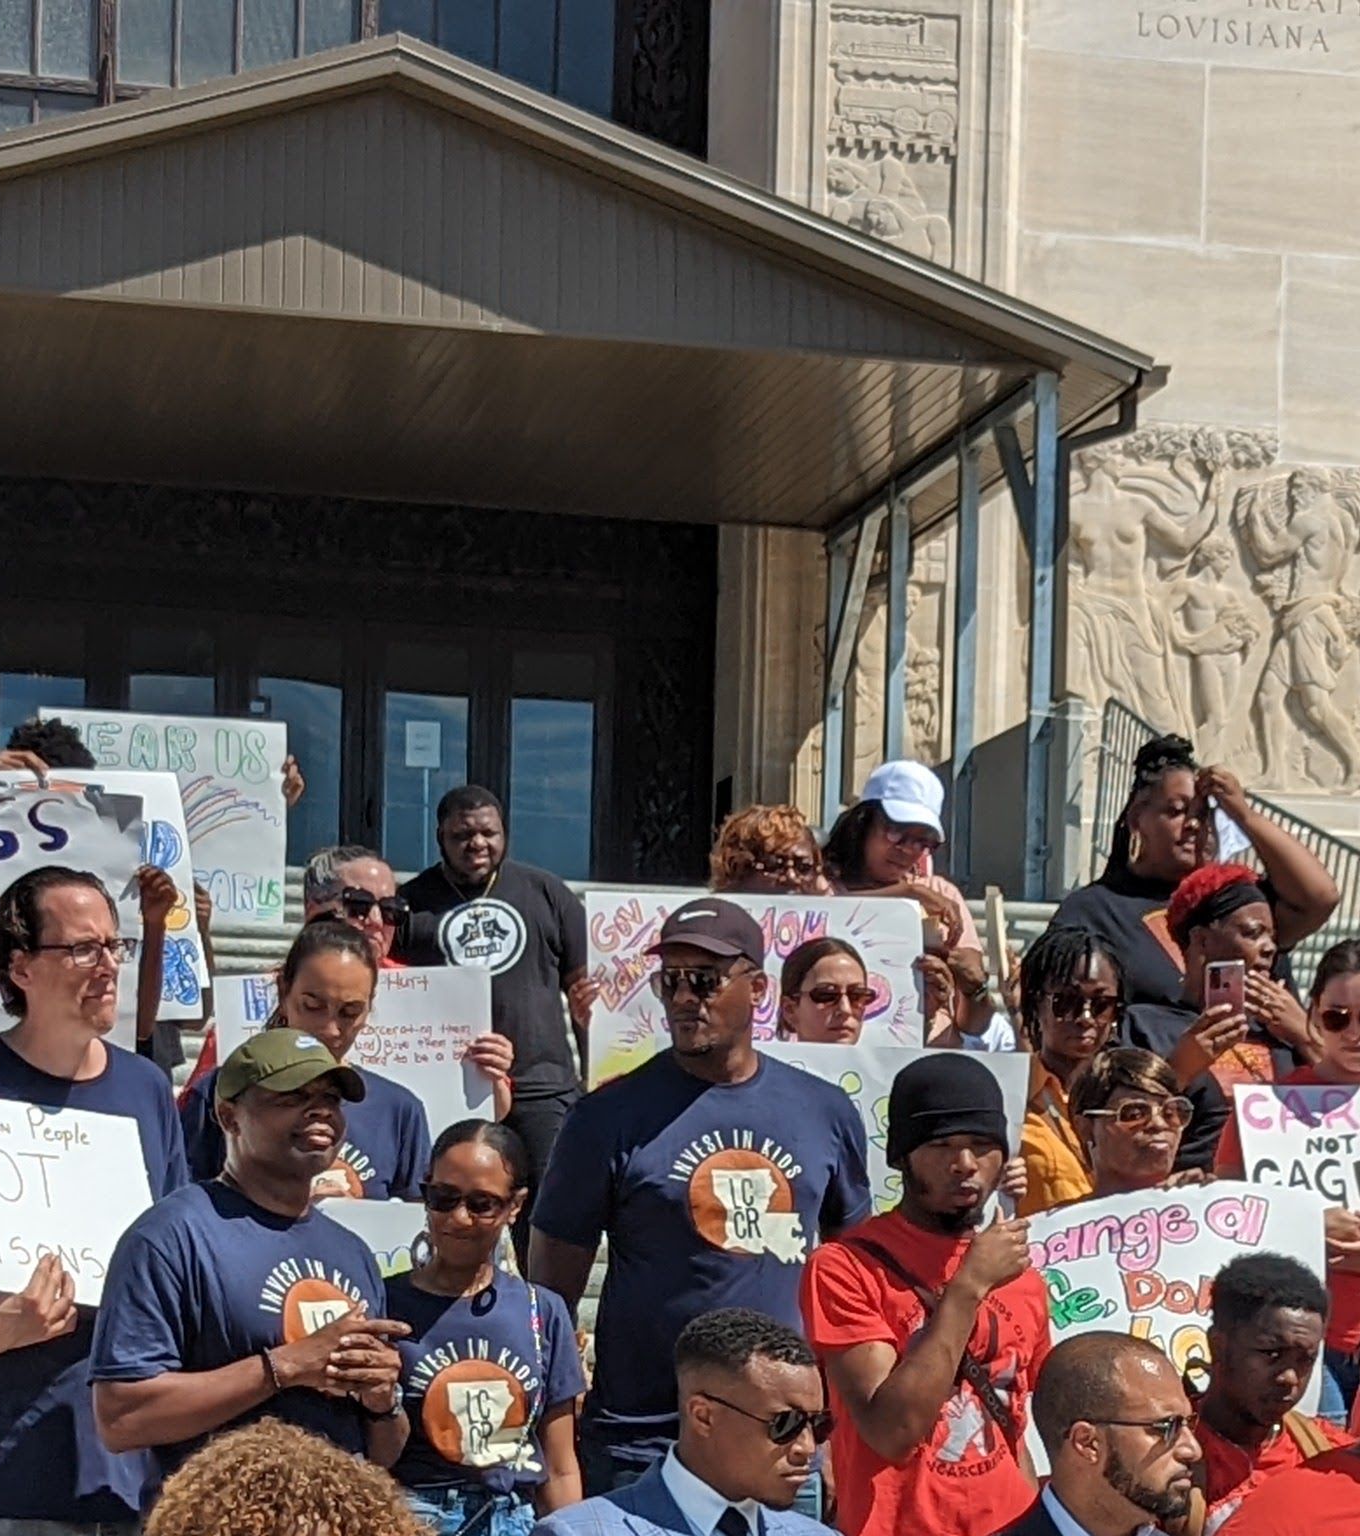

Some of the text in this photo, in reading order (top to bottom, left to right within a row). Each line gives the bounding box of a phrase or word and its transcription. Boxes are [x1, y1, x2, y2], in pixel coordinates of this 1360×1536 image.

[1137, 11, 1331, 53] LOVISIANA
[77, 721, 271, 784] EAR US
[26, 1105, 90, 1151] People
[1306, 1133, 1358, 1154] NOT
[667, 1128, 803, 1182] INVEST IN KIDS
[729, 1178, 755, 1210] LC
[733, 1207, 762, 1240] CR
[259, 1258, 302, 1314] INVEST
[304, 1257, 326, 1280] IN
[406, 1337, 540, 1398] INVEST IN KIDS
